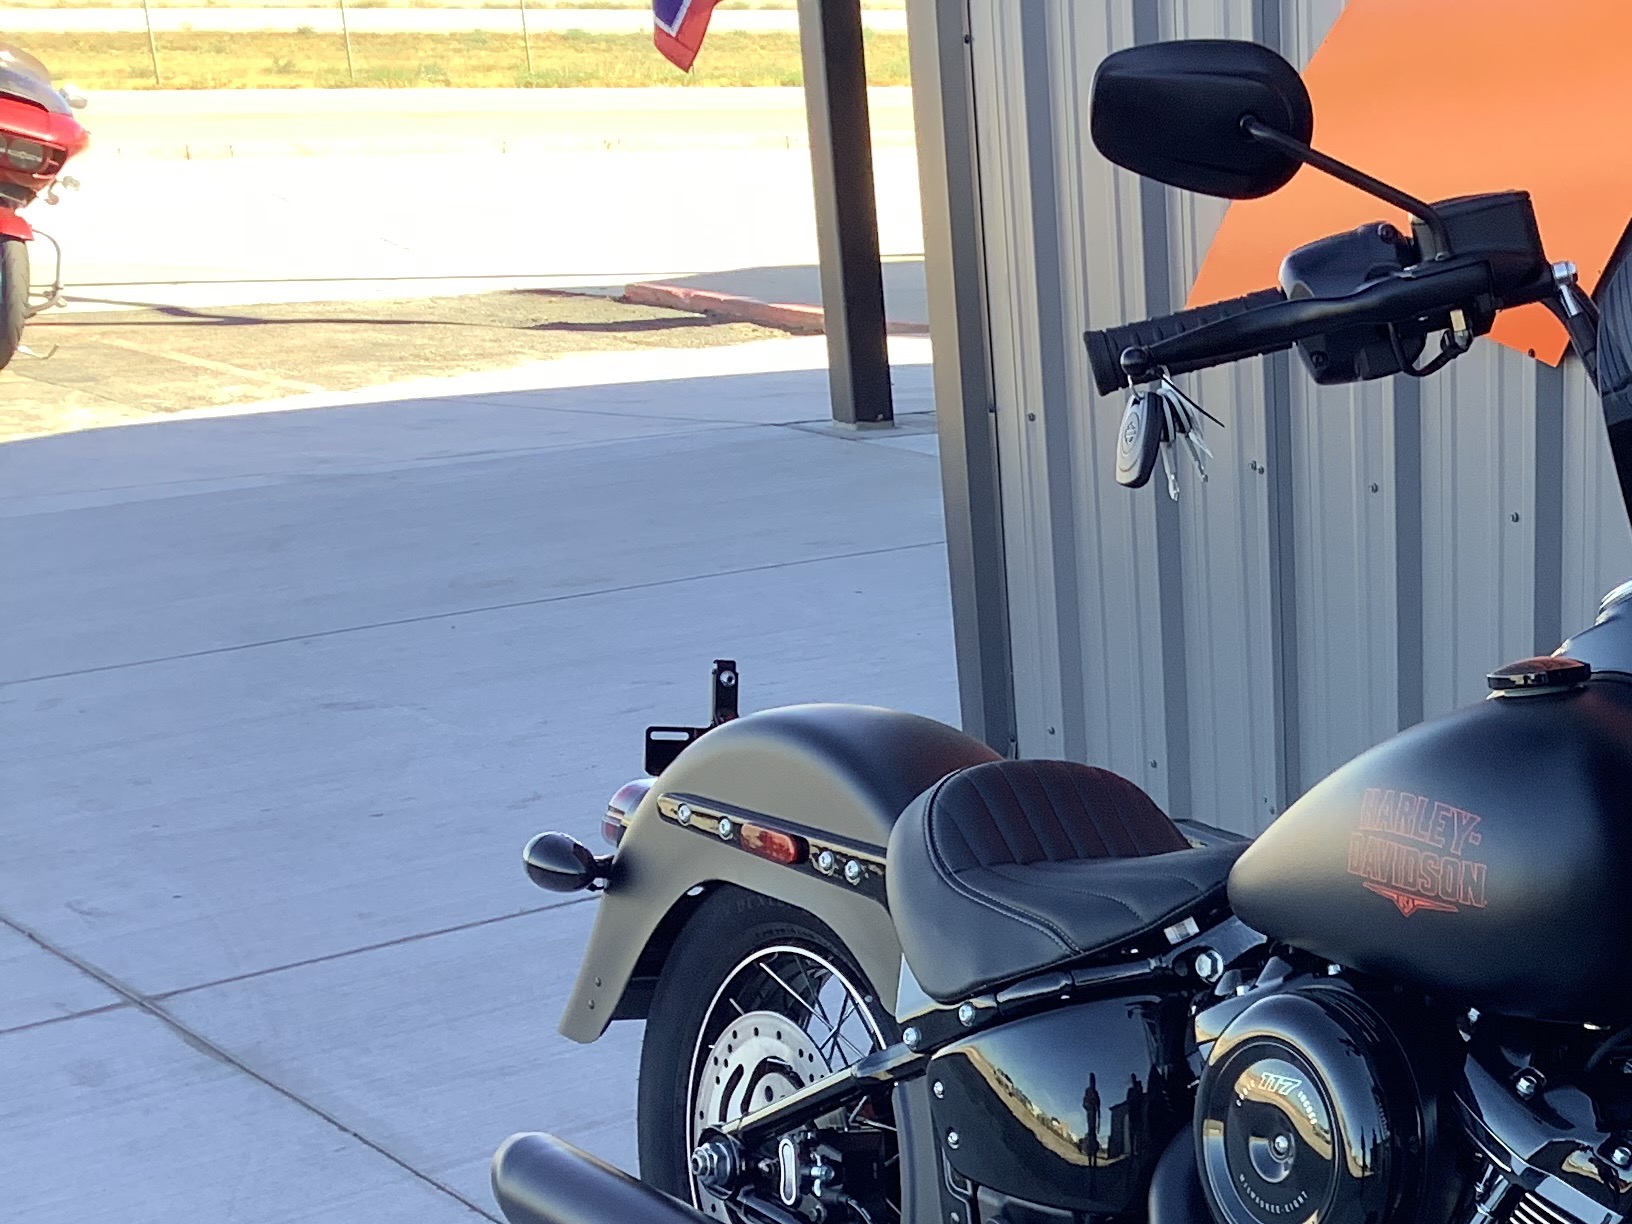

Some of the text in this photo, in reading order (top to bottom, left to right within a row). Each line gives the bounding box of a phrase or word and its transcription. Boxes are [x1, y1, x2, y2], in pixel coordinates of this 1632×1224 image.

[1359, 787, 1482, 856] HARLEY-
[1346, 831, 1488, 908] DAVIDSON
[1257, 1071, 1303, 1096] 117
